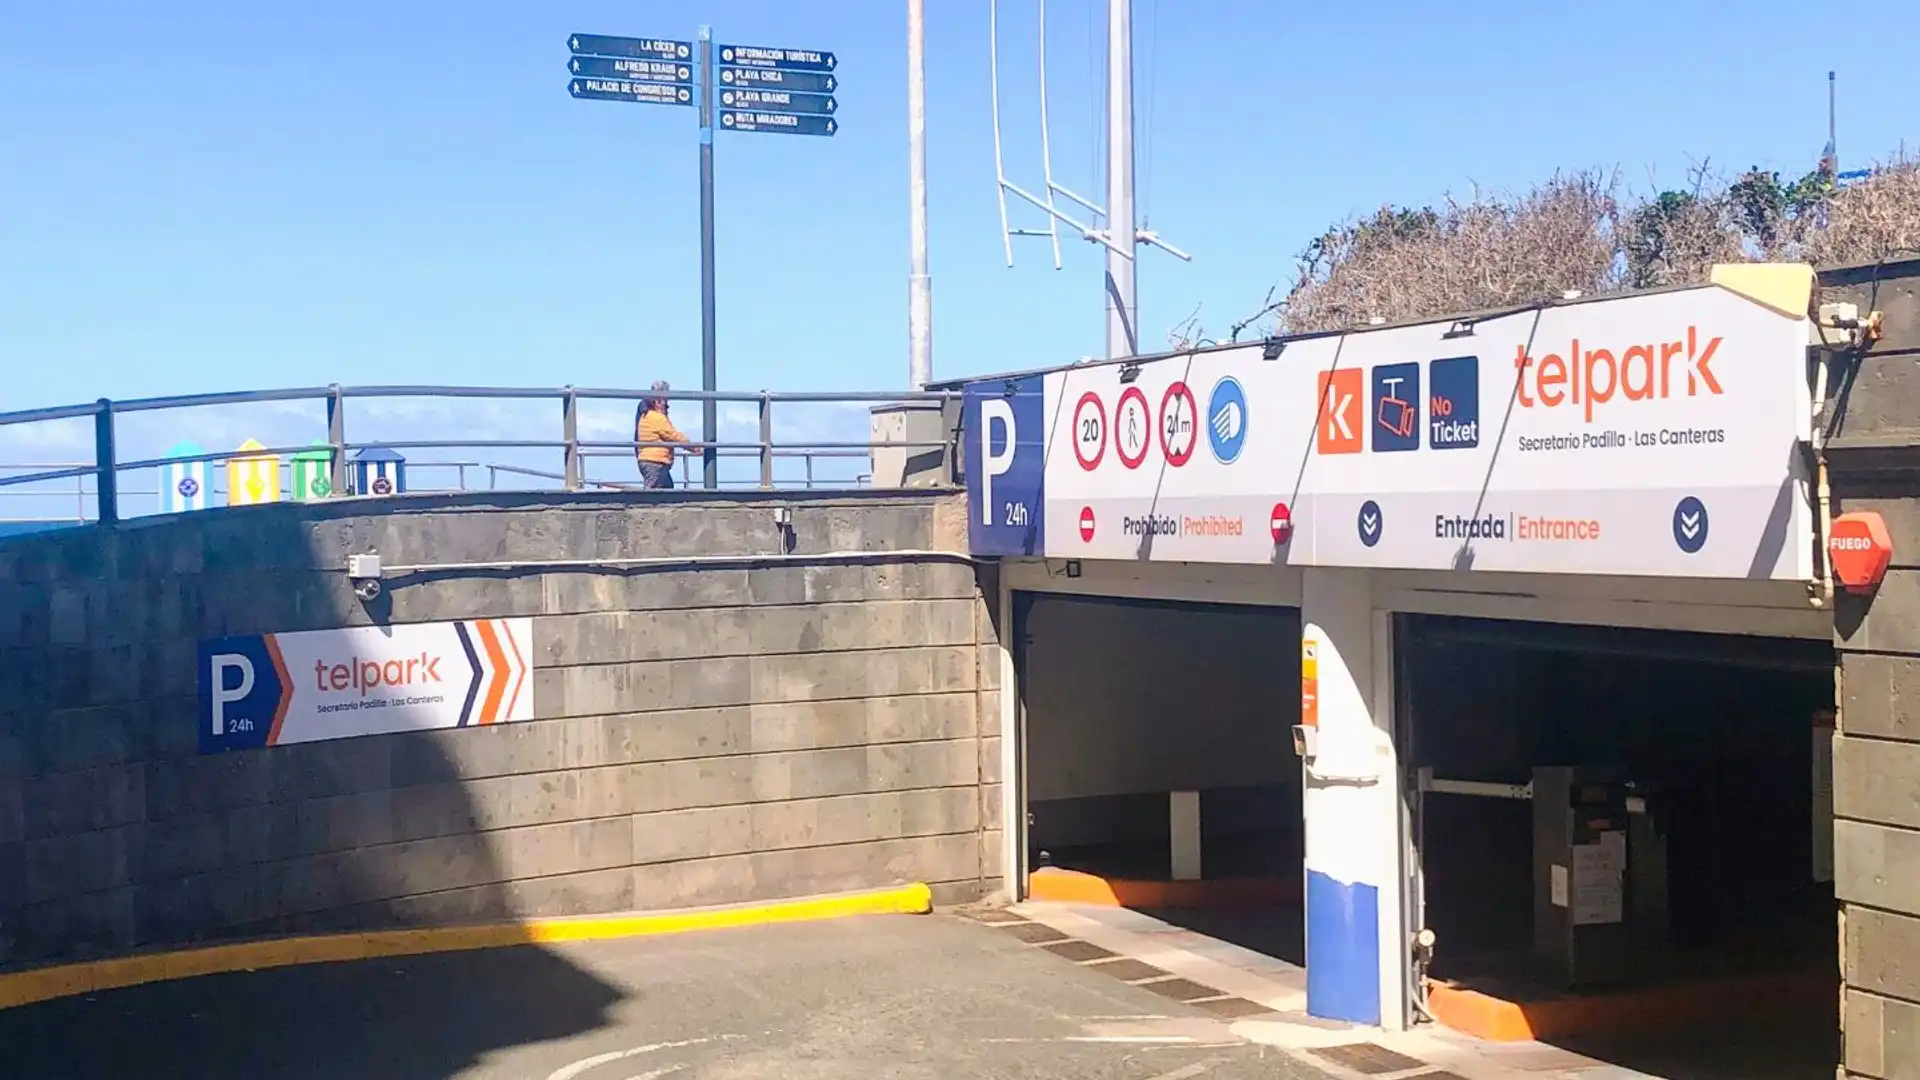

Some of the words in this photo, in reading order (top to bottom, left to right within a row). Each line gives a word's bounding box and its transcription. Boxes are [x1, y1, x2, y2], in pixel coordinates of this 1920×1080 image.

[640, 40, 652, 51] LA
[614, 60, 649, 72] ALFREDO
[650, 62, 676, 74] KRAUS
[735, 69, 760, 81] PLAYA
[760, 71, 783, 82] CHICA
[586, 80, 620, 92] PALACIO
[621, 83, 631, 93] DE
[633, 84, 676, 96] CONGRESOS
[735, 91, 760, 102] PLAYA
[761, 92, 791, 104] GRANDE
[735, 112, 755, 123] RUTA
[756, 114, 799, 127] MIRADORES
[1515, 325, 1725, 422] telpark
[1431, 395, 1452, 418] No
[1082, 419, 1099, 443] 20
[1431, 421, 1478, 444] Ticket
[1518, 432, 1579, 452] Secretario
[1582, 429, 1627, 449] Padilla
[1633, 430, 1657, 447] Las
[1659, 427, 1725, 446] Canteras
[980, 398, 1017, 526] P
[1005, 502, 1029, 526] 24h
[1123, 515, 1177, 536] Prohibido
[1184, 515, 1243, 537] Prohibited
[1435, 515, 1505, 540] Entrada
[1517, 515, 1601, 541] Entrance
[1830, 536, 1872, 551] FUEGO
[315, 651, 442, 697] telpark
[211, 653, 255, 736] P
[317, 698, 358, 714] Secretario
[359, 697, 387, 710] Padilla
[391, 698, 405, 707] Las
[406, 695, 444, 704] Canteras
[229, 718, 254, 733] 24h
